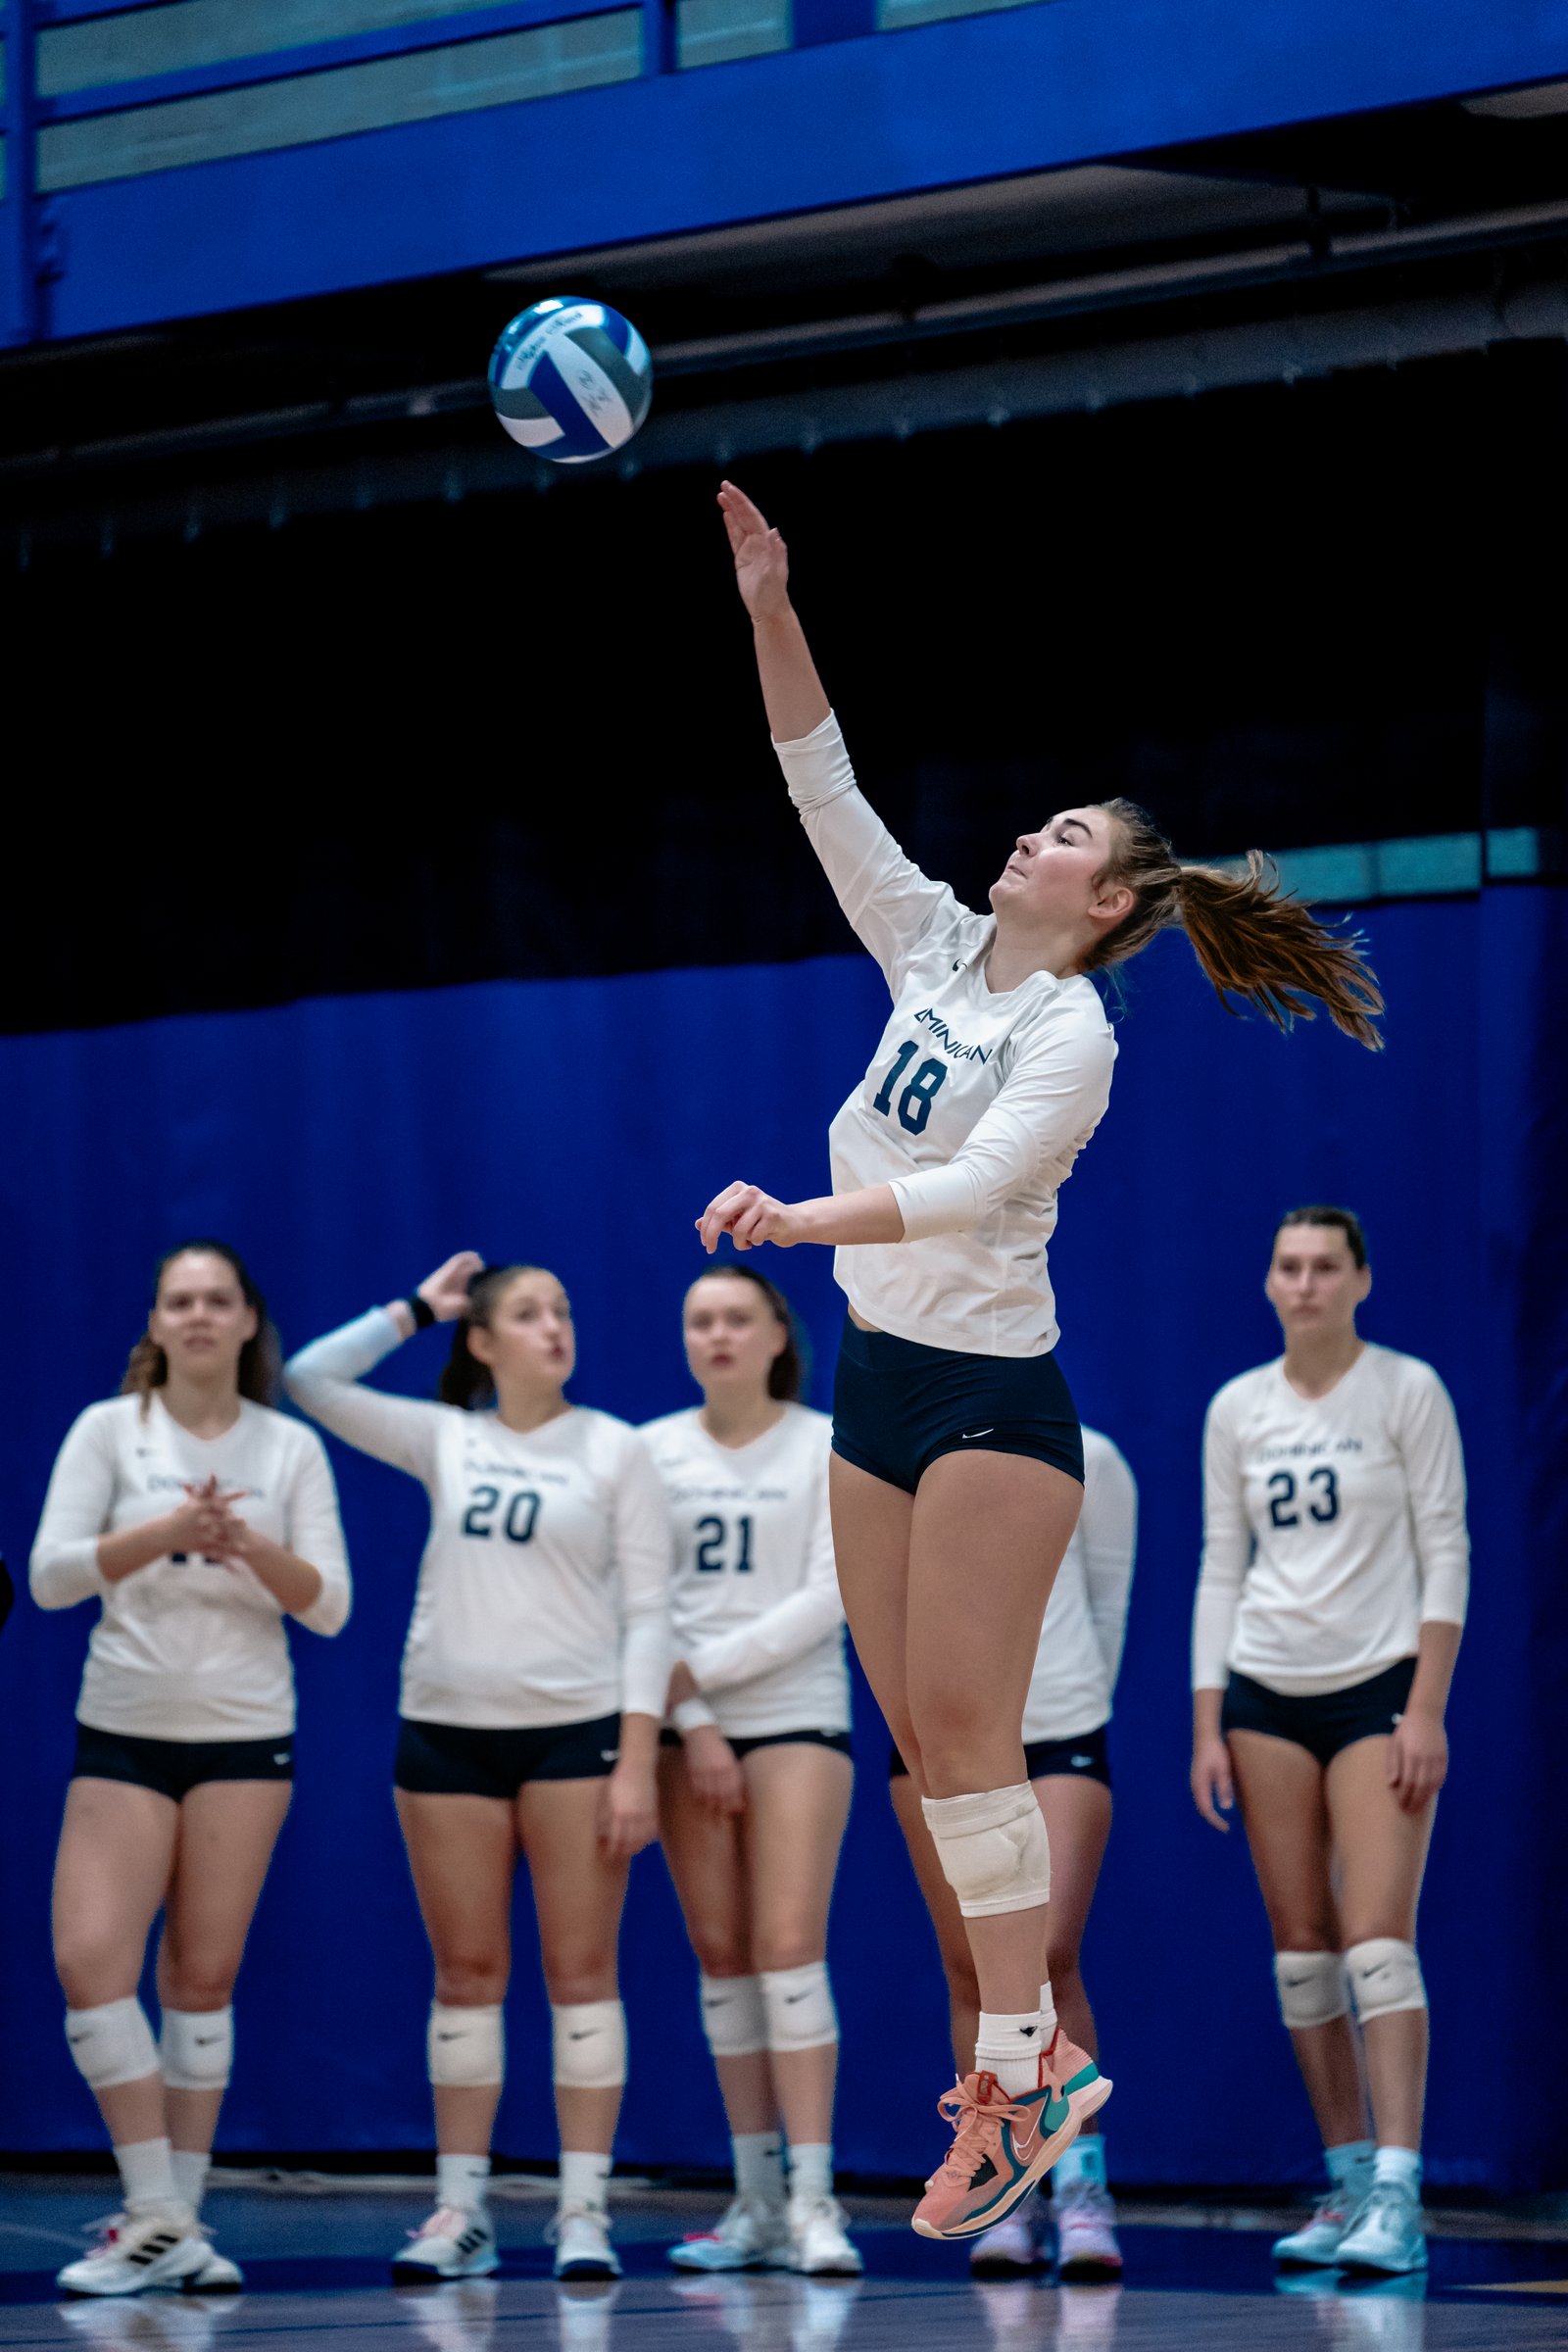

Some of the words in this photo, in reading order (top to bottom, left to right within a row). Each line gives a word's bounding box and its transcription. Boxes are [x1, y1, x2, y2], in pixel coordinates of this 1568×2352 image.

[873, 1040, 948, 1136] 18
[463, 1486, 542, 1544] 20
[1268, 1466, 1340, 1527] 23
[695, 1514, 754, 1573] 21
